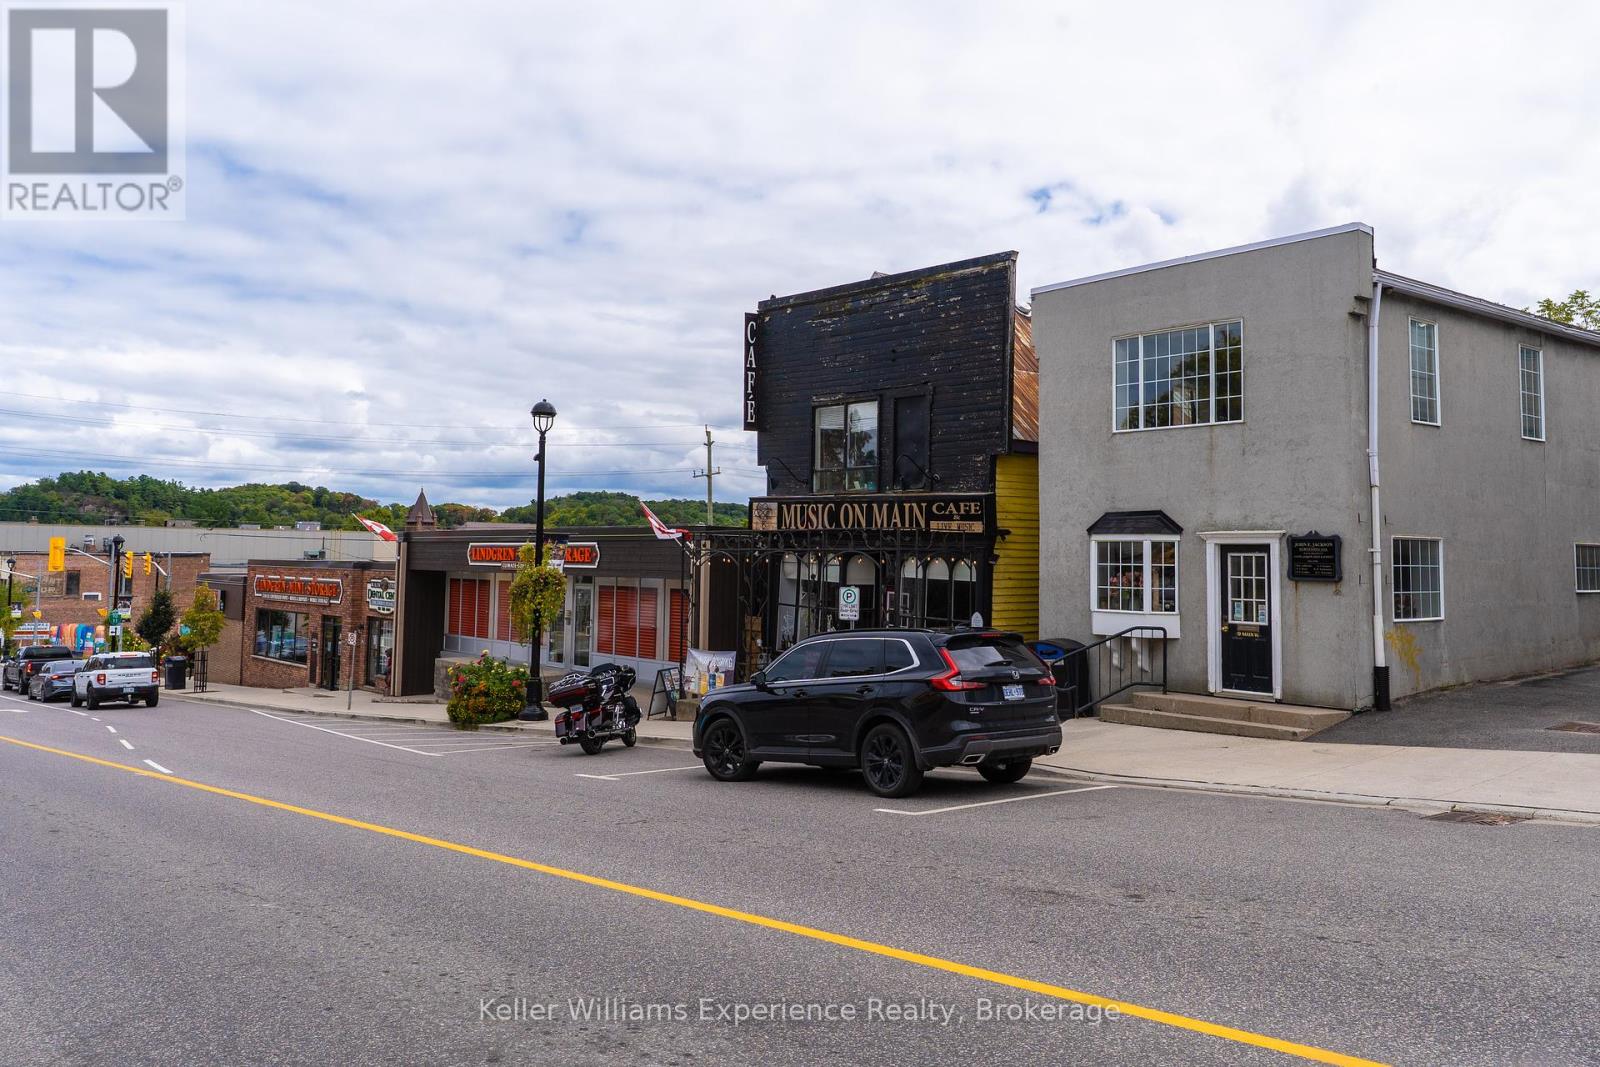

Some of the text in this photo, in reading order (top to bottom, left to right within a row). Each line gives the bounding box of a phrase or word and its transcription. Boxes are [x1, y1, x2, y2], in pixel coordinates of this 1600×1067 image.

[746, 321, 757, 423] CAFÉ
[781, 501, 927, 530] MUSIC ON MAIN
[931, 501, 982, 515] CAFE
[470, 547, 591, 562] LINDGREN RAGE
[306, 583, 337, 597] STORAGE
